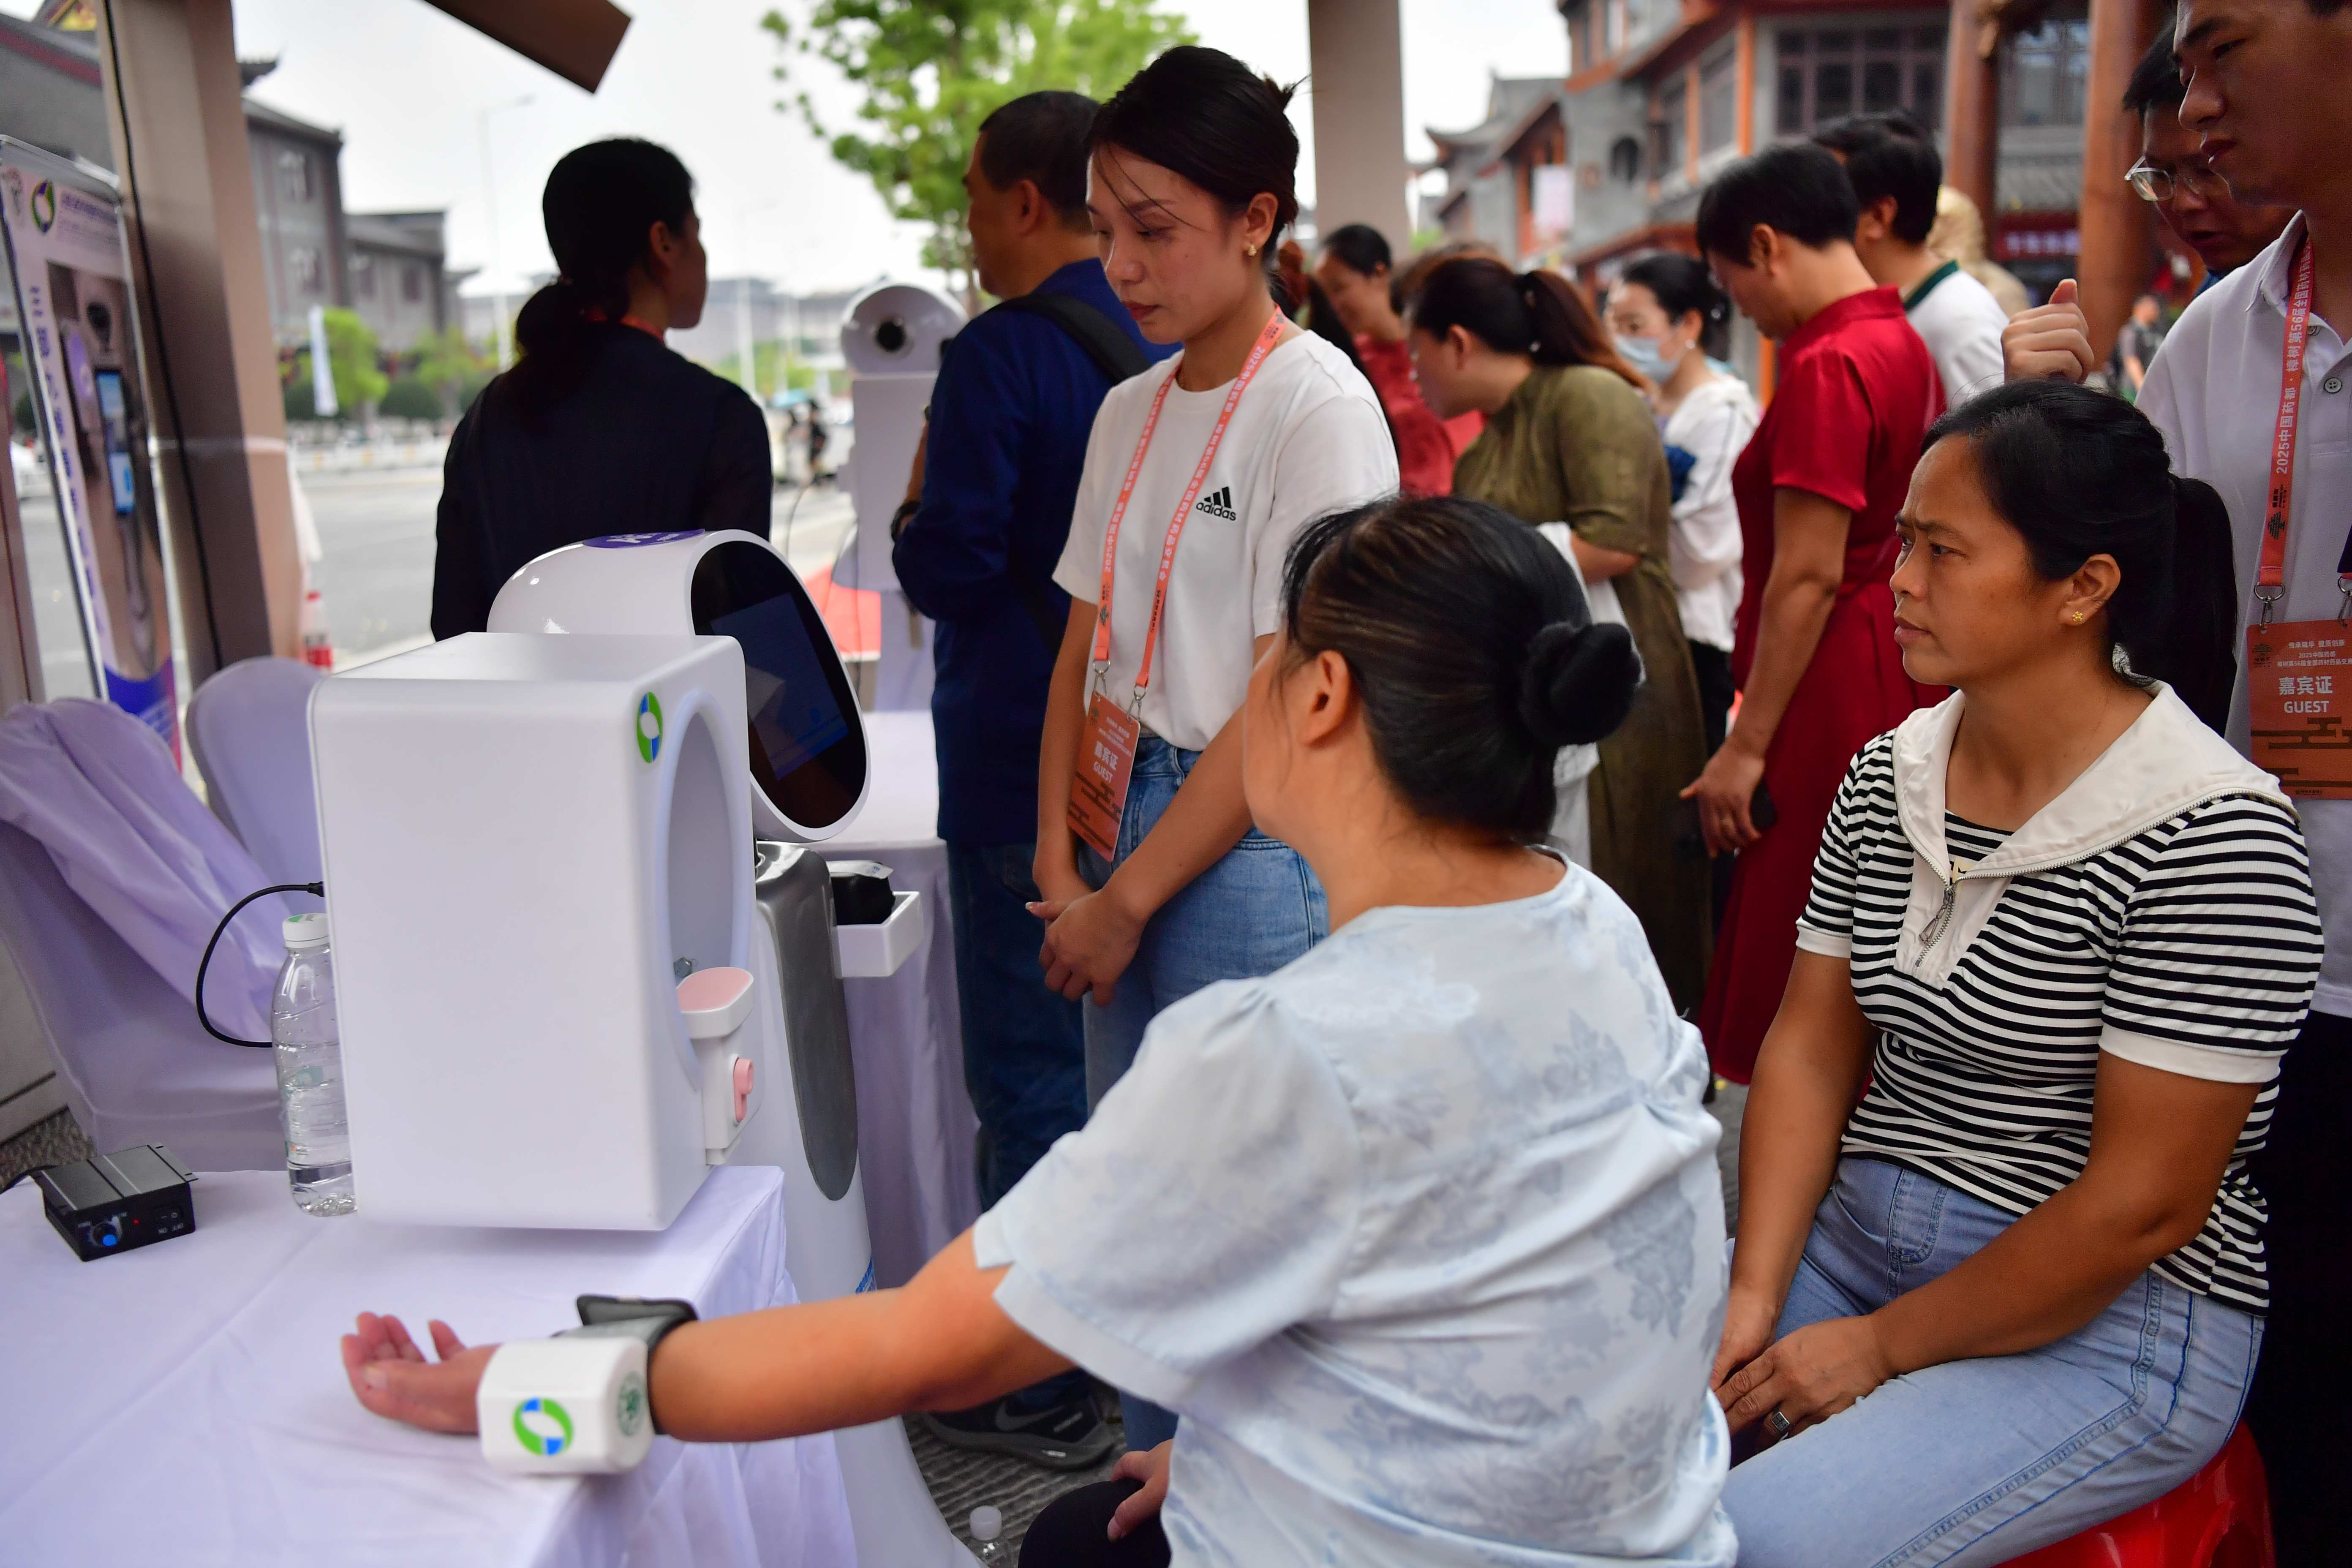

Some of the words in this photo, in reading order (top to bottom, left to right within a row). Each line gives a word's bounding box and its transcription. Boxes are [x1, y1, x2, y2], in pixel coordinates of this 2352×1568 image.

[1196, 502, 1236, 521] adidas
[2279, 676, 2333, 695] 嘉宾证
[2284, 700, 2329, 713] GUEST
